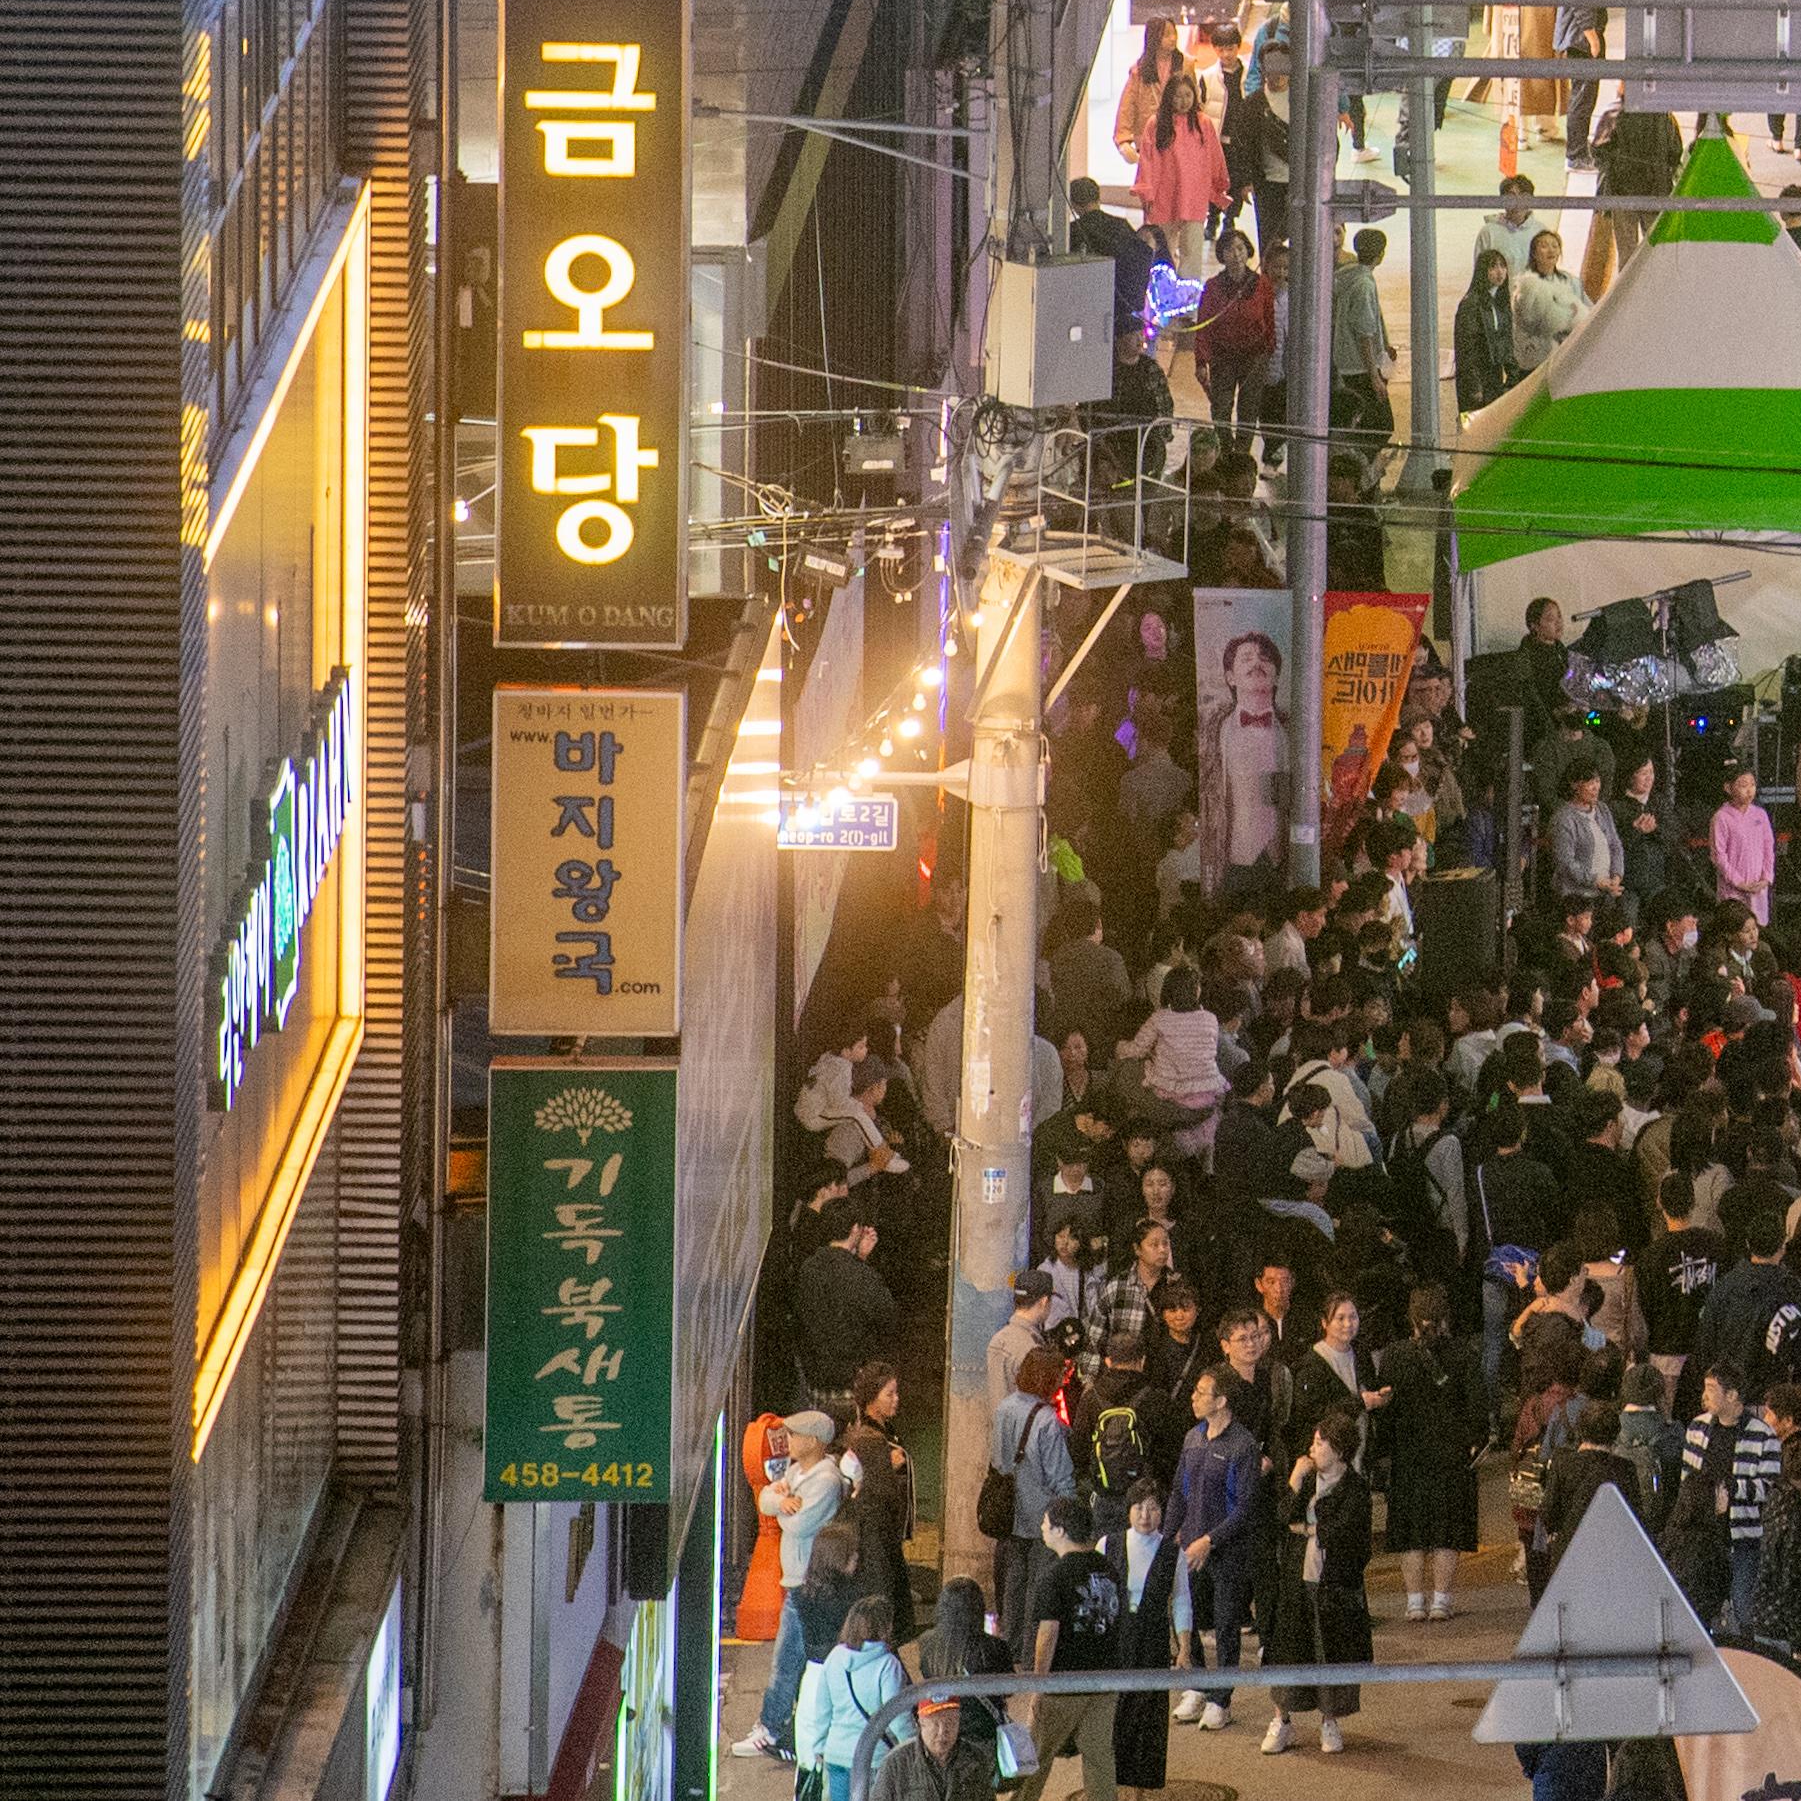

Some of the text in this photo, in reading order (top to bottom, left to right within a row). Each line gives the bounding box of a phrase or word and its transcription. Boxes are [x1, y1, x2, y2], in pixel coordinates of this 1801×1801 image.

[520, 41, 659, 566] 금오당
[506, 605, 674, 629] KUM O DANG
[550, 730, 624, 996] 바지왕국
[533, 1156, 625, 1451] 기독북새통
[499, 1461, 654, 1489] 458-4412
